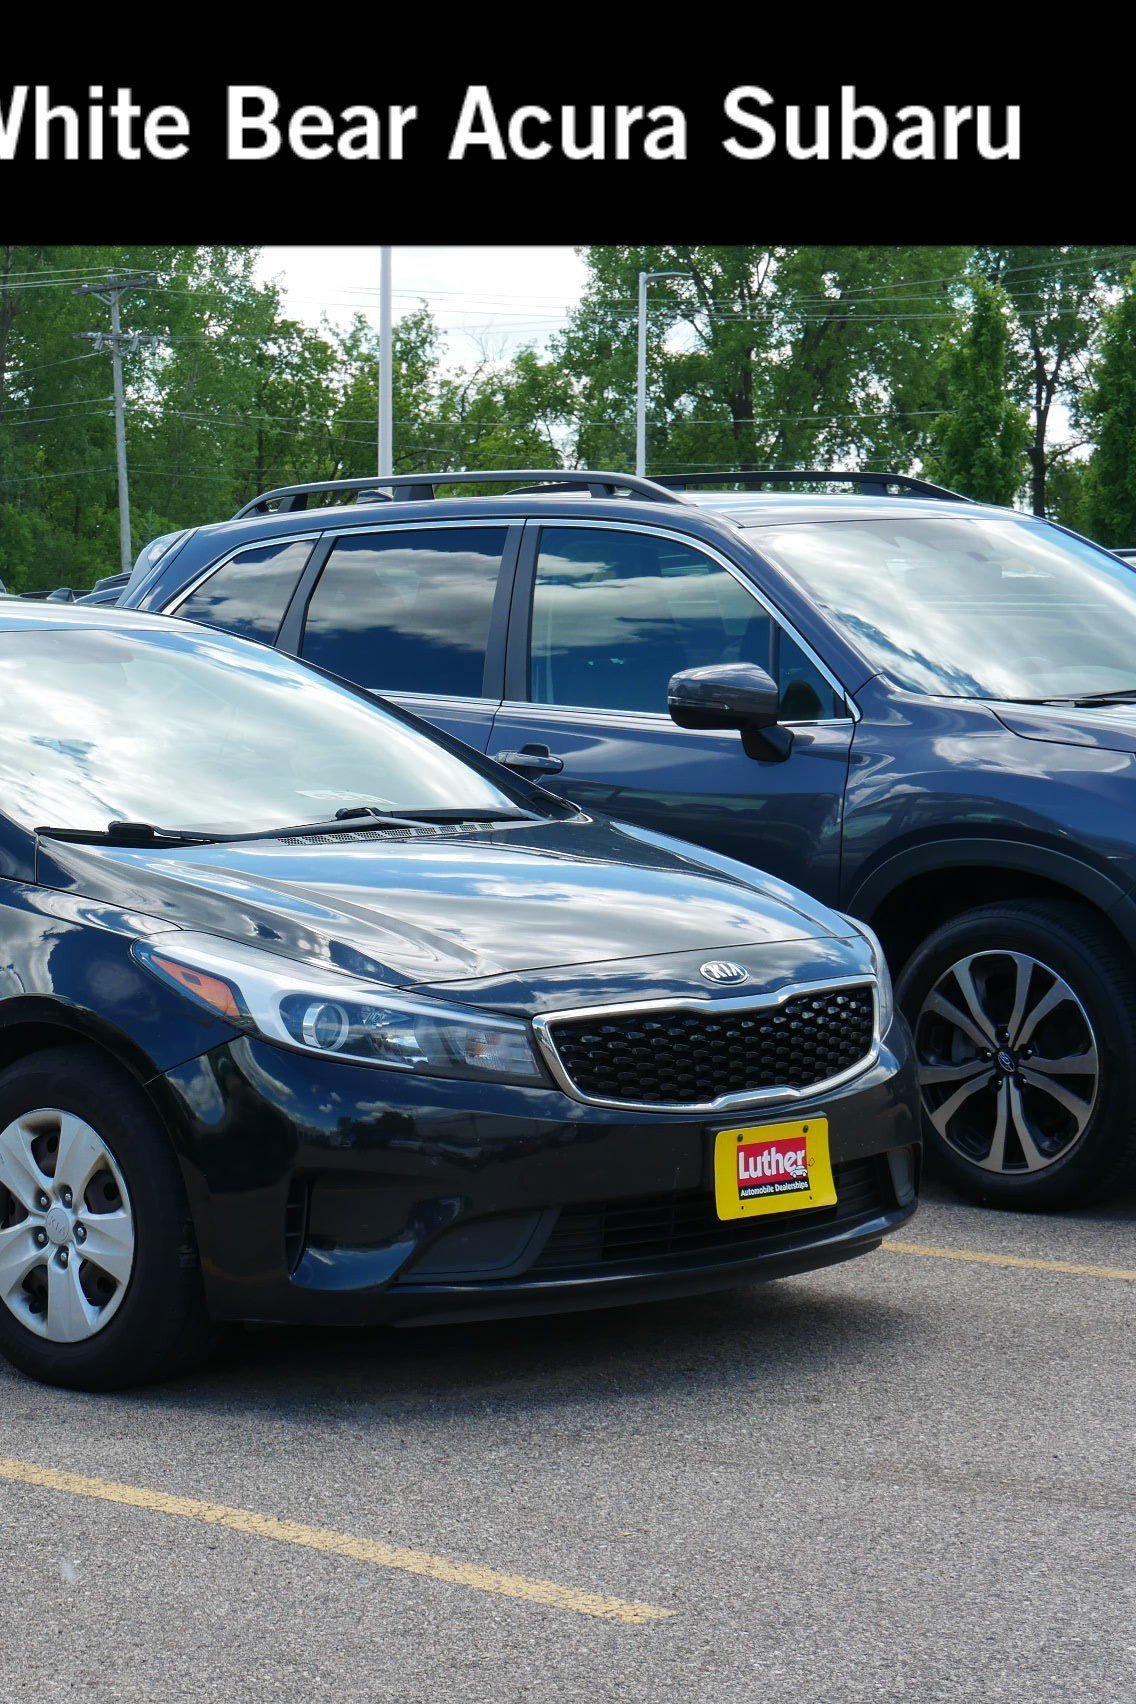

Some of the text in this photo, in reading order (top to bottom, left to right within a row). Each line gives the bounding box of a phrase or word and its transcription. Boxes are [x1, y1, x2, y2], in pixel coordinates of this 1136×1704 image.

[738, 1147, 806, 1180] Luther
[740, 1181, 808, 1197] Automobile Dealerships
